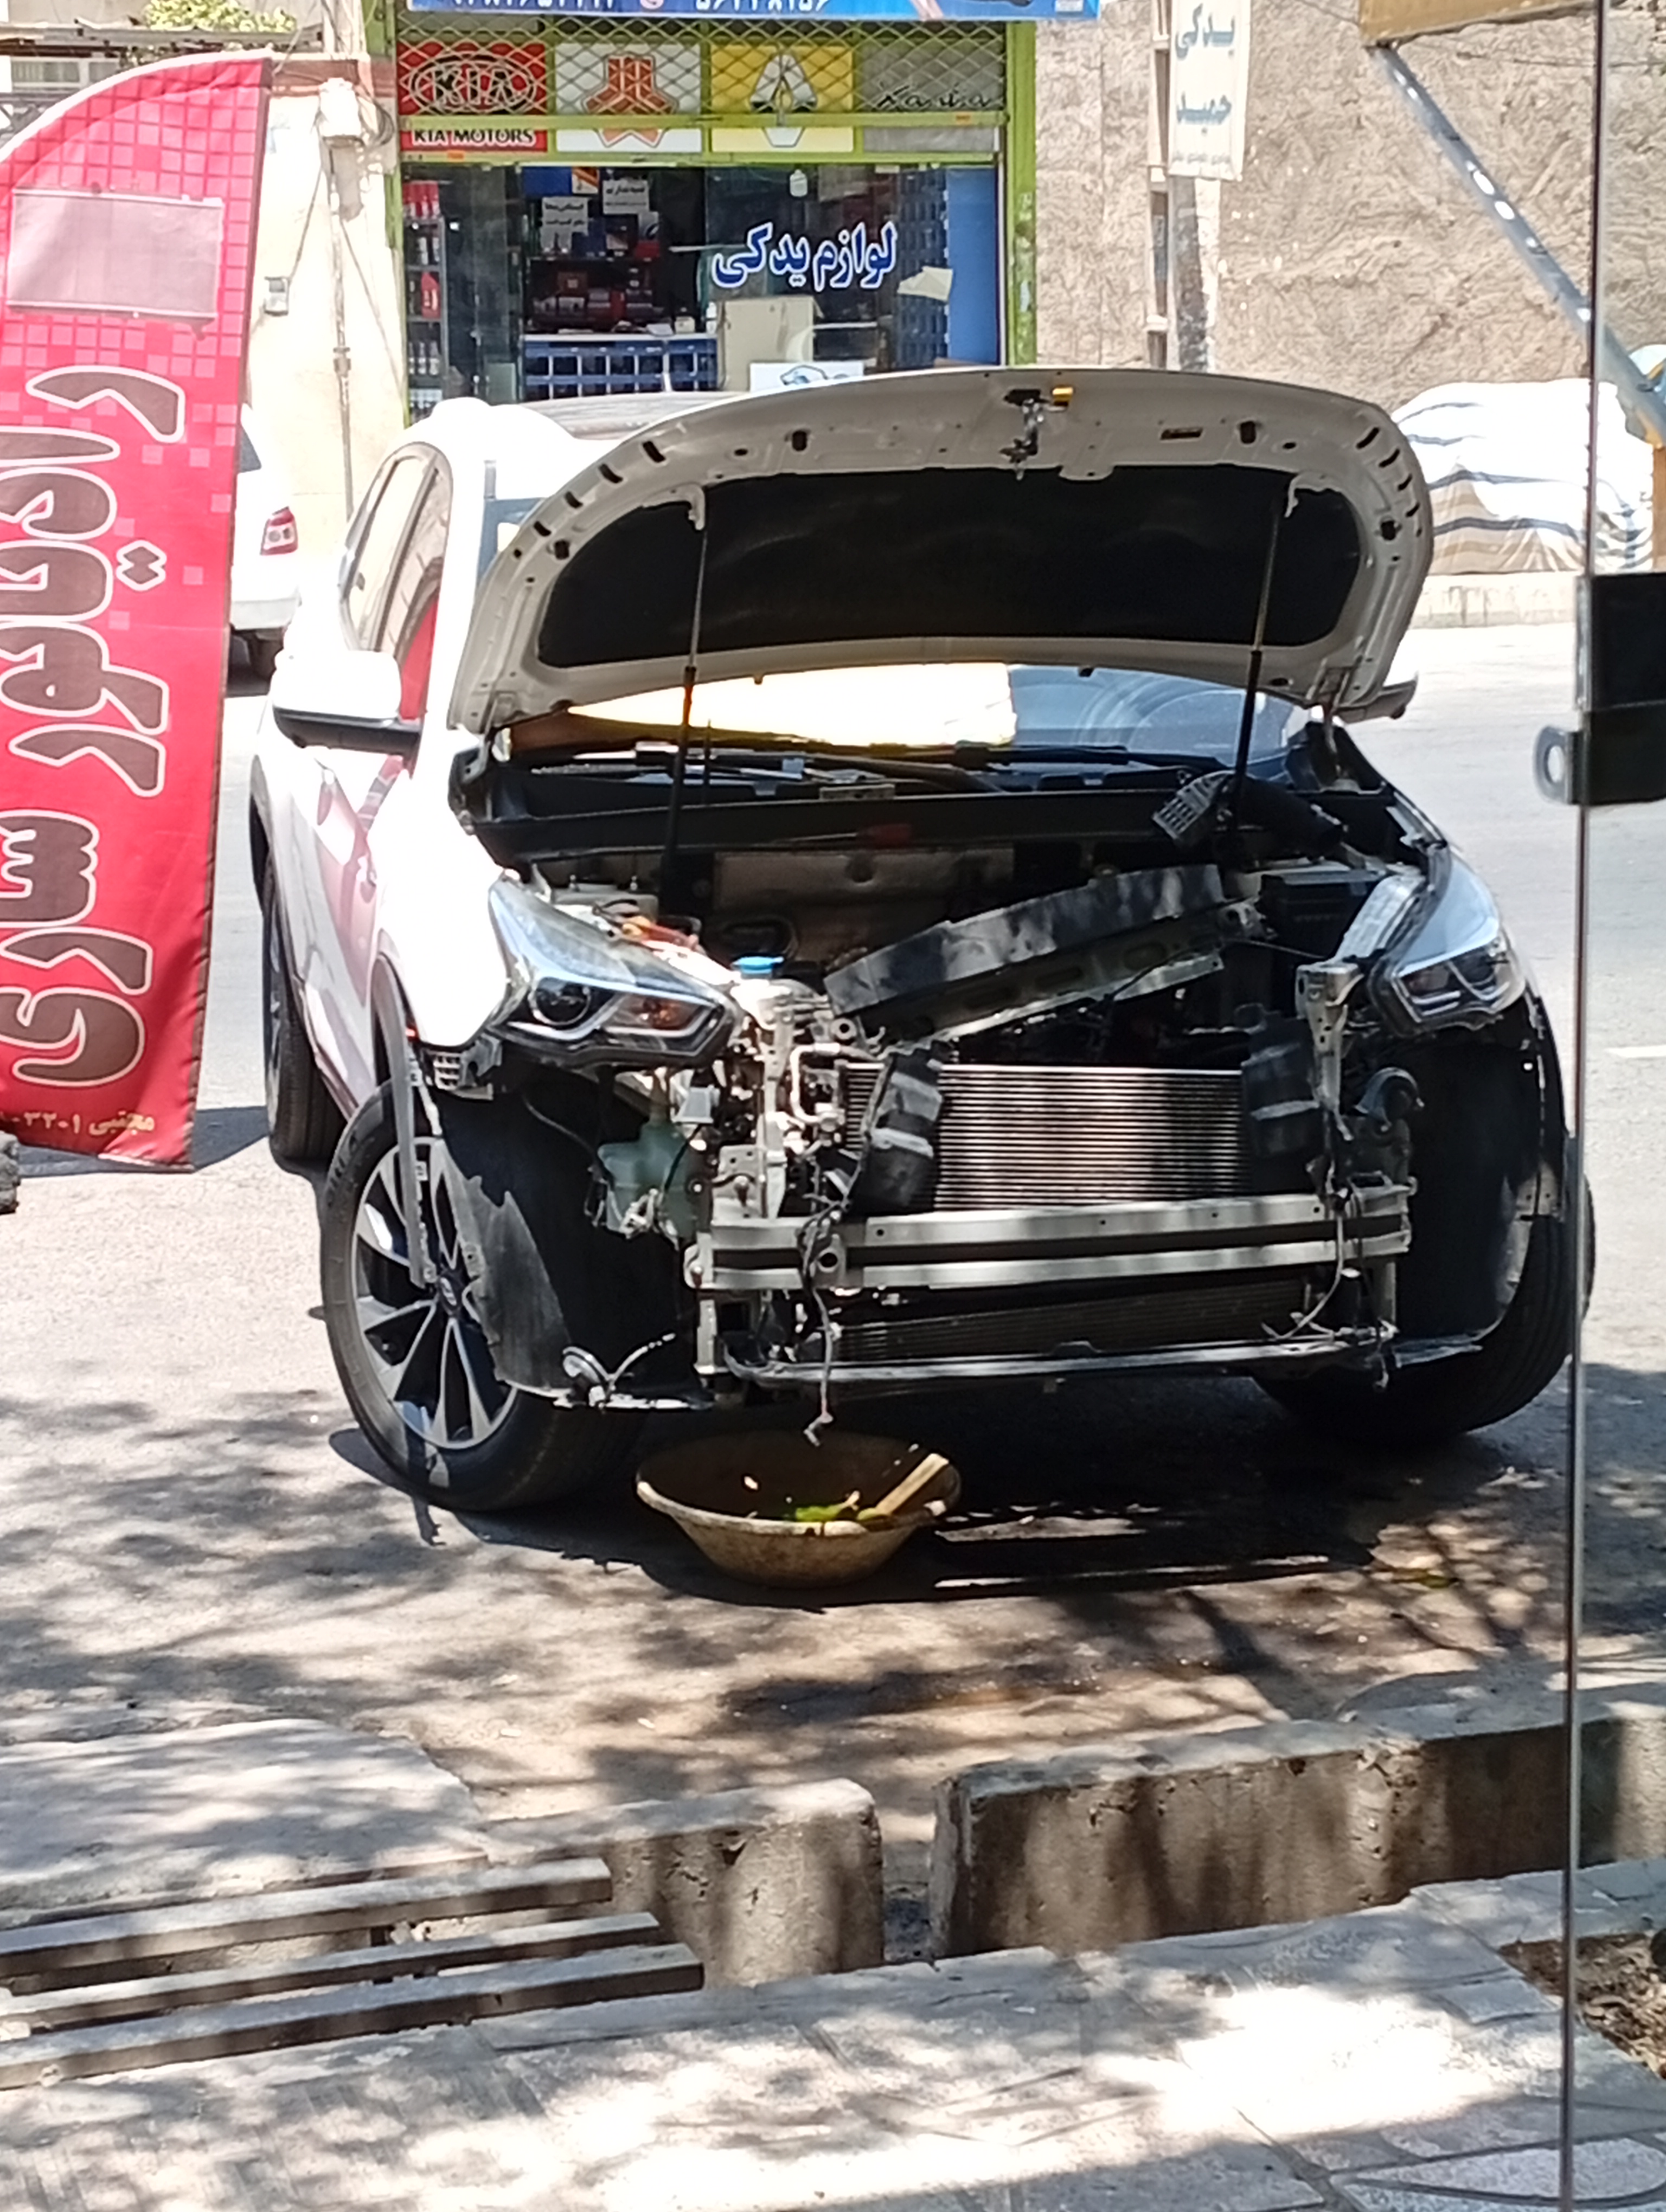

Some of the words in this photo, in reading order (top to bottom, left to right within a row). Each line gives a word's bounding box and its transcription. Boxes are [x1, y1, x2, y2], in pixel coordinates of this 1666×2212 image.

[431, 66, 519, 106] KIA
[414, 129, 447, 144] KIA
[452, 129, 535, 145] MOTORS
[712, 221, 810, 288] یدکی
[813, 221, 899, 292] لوازم
